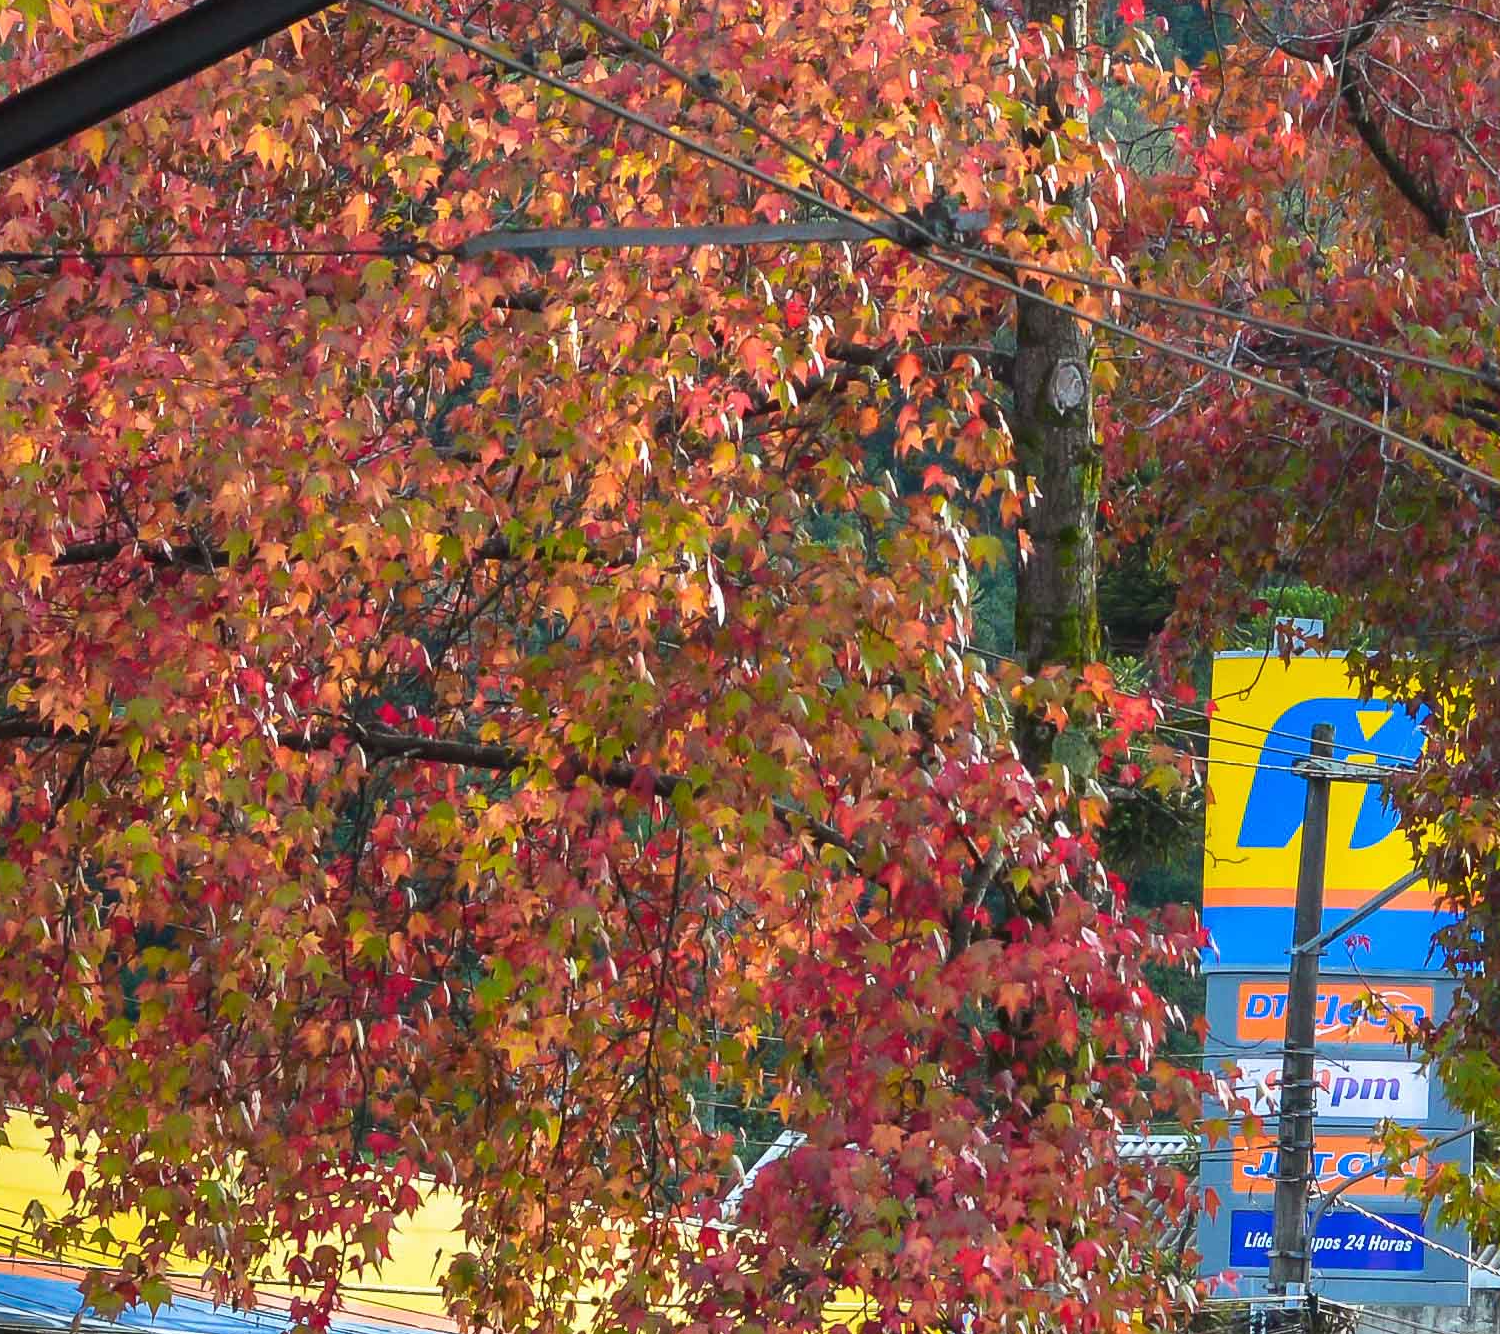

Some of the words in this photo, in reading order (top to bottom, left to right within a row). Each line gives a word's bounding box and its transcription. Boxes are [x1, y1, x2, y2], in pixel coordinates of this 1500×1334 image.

[1244, 1231, 1273, 1248] Líde
[1344, 1234, 1365, 1250] 24
[1367, 1236, 1412, 1252] Horas
